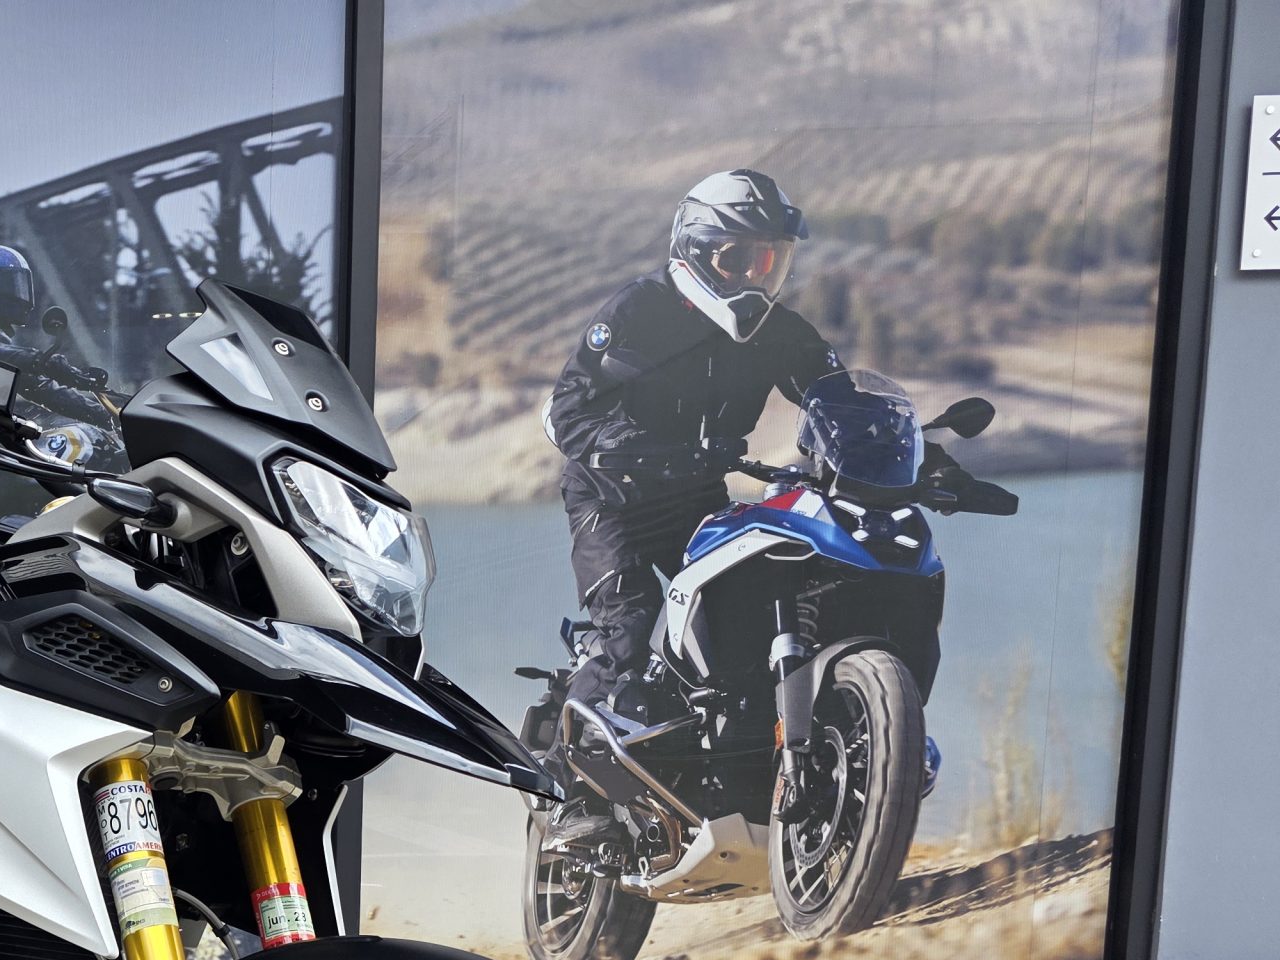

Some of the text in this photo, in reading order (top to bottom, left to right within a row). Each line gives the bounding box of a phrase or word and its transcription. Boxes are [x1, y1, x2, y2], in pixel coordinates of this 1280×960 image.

[110, 784, 145, 796] COSTA
[267, 915, 291, 929] jun.
[293, 911, 307, 923] 23
